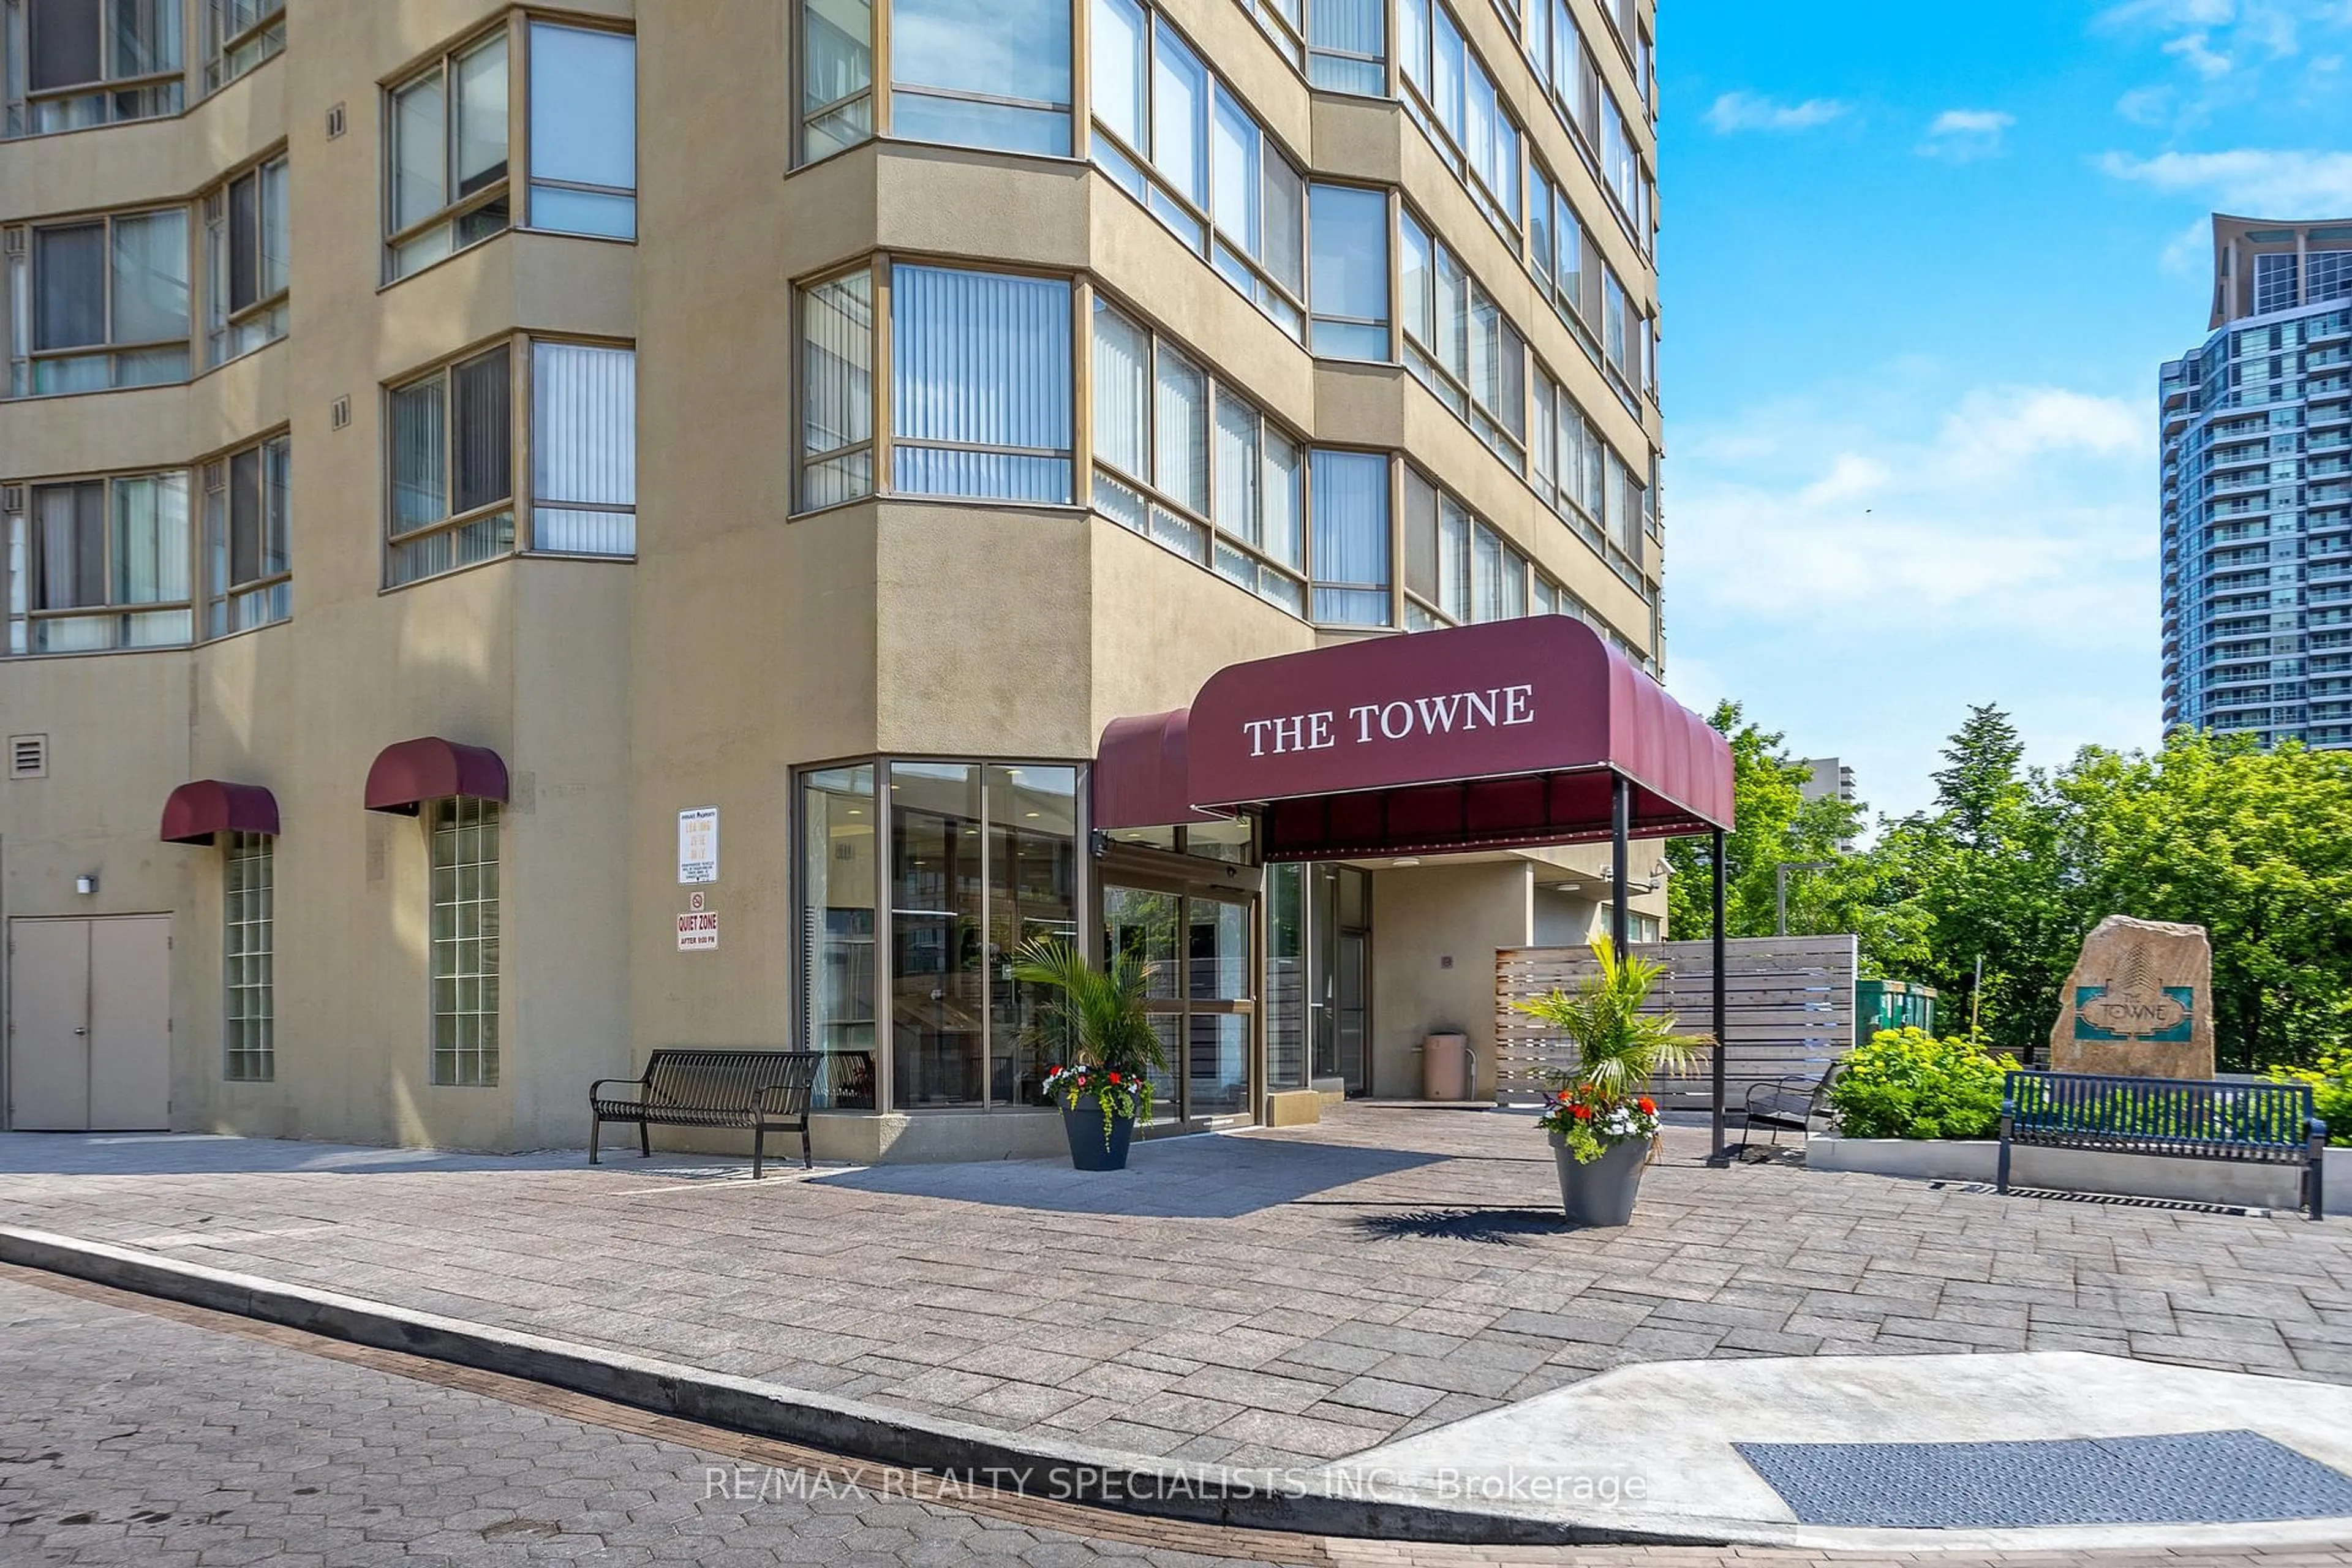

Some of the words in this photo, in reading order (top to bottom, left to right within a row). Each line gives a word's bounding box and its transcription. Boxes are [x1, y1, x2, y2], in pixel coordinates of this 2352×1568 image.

[1243, 710, 1335, 757] THE
[1349, 685, 1534, 743] TOWNE
[679, 915, 697, 932] QUIET
[699, 914, 716, 930] ZONE
[2100, 1004, 2166, 1020] TOWNE
